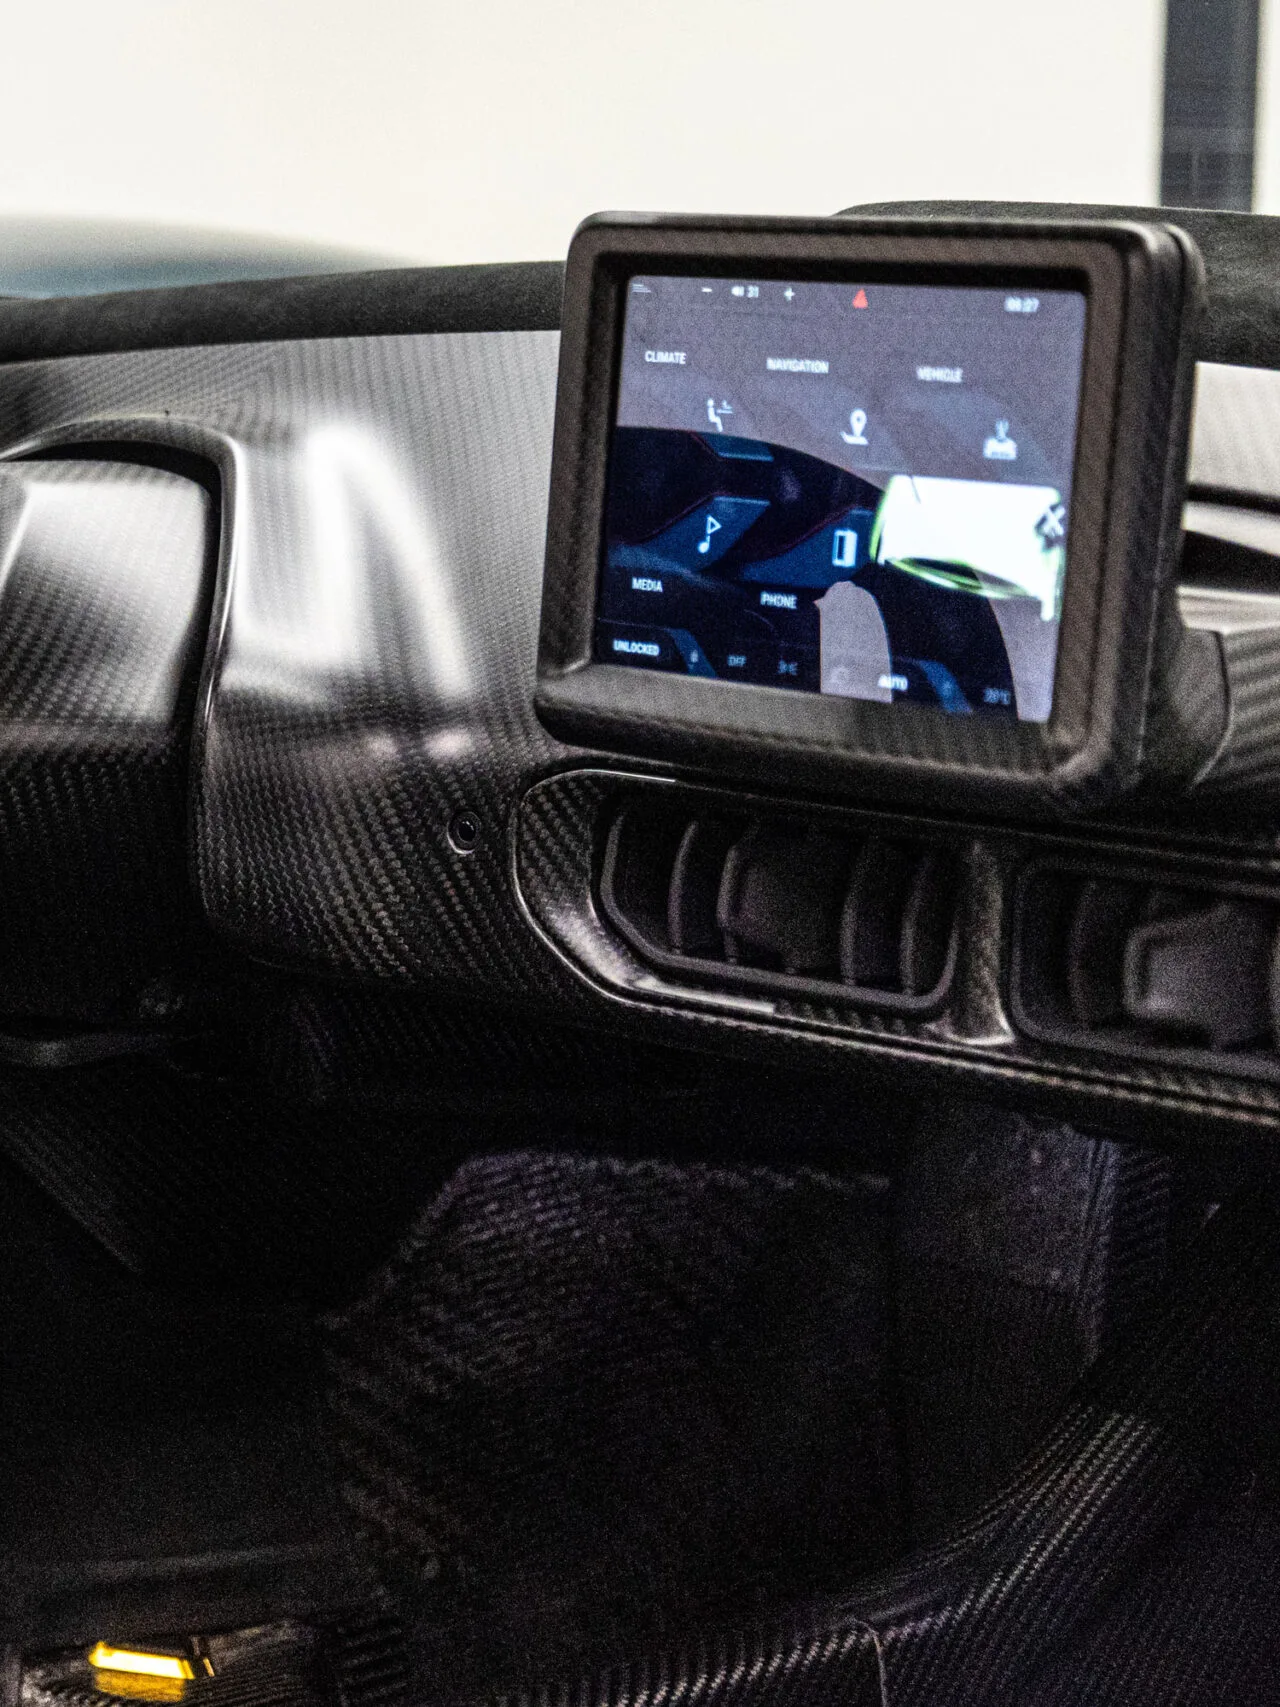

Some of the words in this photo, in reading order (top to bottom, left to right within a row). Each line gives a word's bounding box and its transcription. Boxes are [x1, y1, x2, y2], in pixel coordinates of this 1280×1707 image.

[645, 350, 687, 365] CLIMATE
[766, 358, 829, 374] NAVIGATION
[916, 366, 963, 383] VEHICLE
[632, 577, 663, 593] MEDIA
[760, 591, 797, 609] PHONE
[613, 638, 660, 657] UNLOCKED
